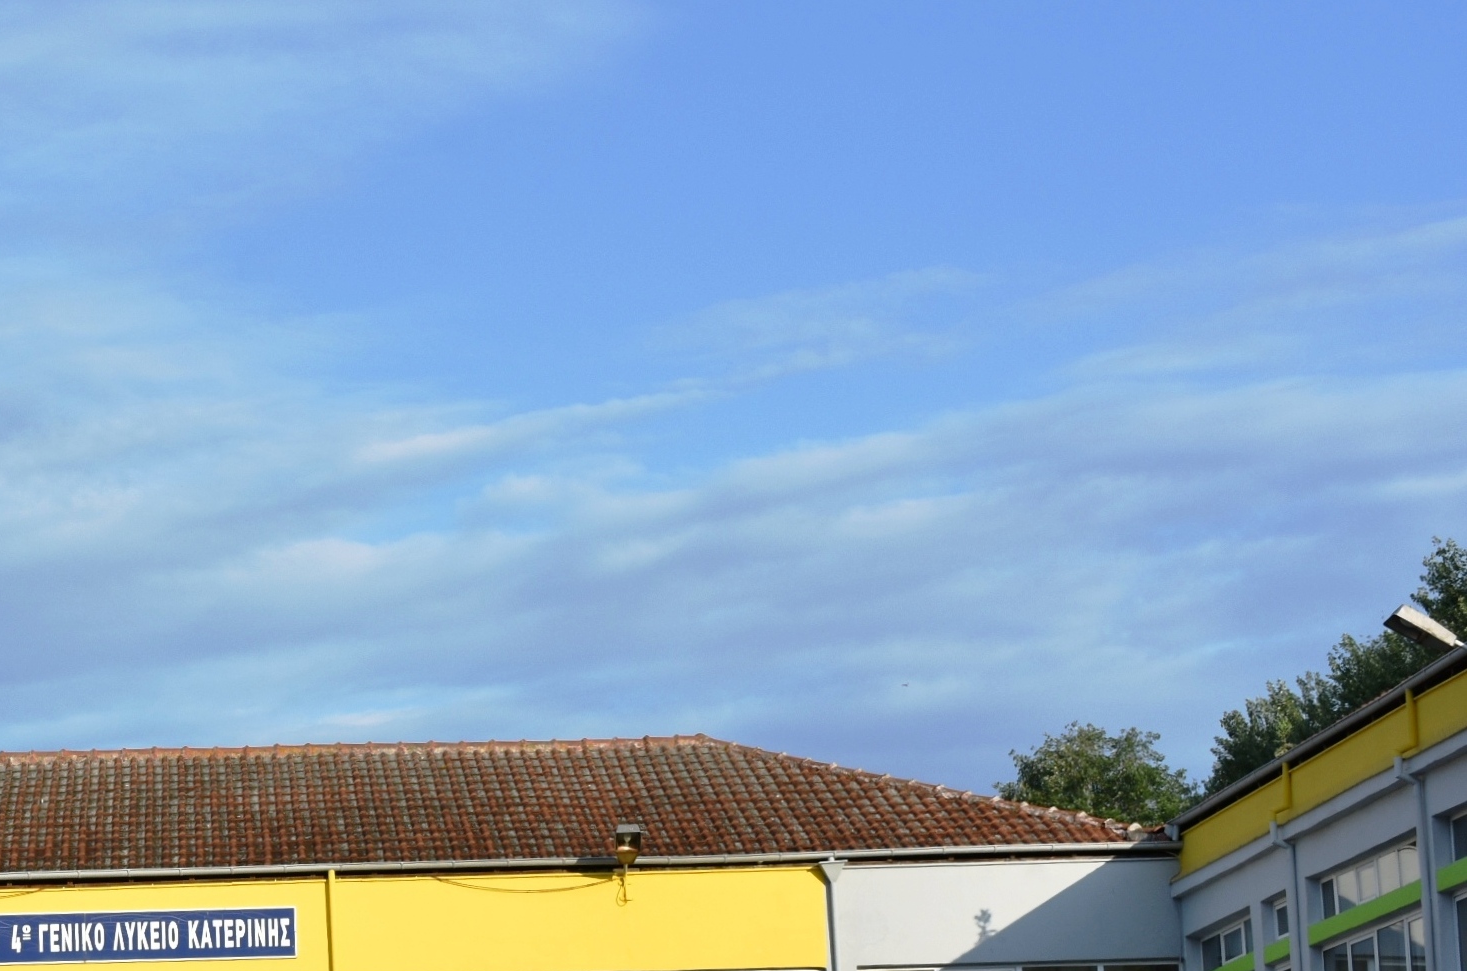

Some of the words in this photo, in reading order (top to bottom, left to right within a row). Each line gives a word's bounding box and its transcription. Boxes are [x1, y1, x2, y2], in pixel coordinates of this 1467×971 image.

[38, 922, 105, 953] ΓΕΝΙΚΟ
[113, 920, 179, 951] ΛΥΚΕΙΟ
[187, 918, 291, 949] ΚΑΤΕΡΙΝΗΣ
